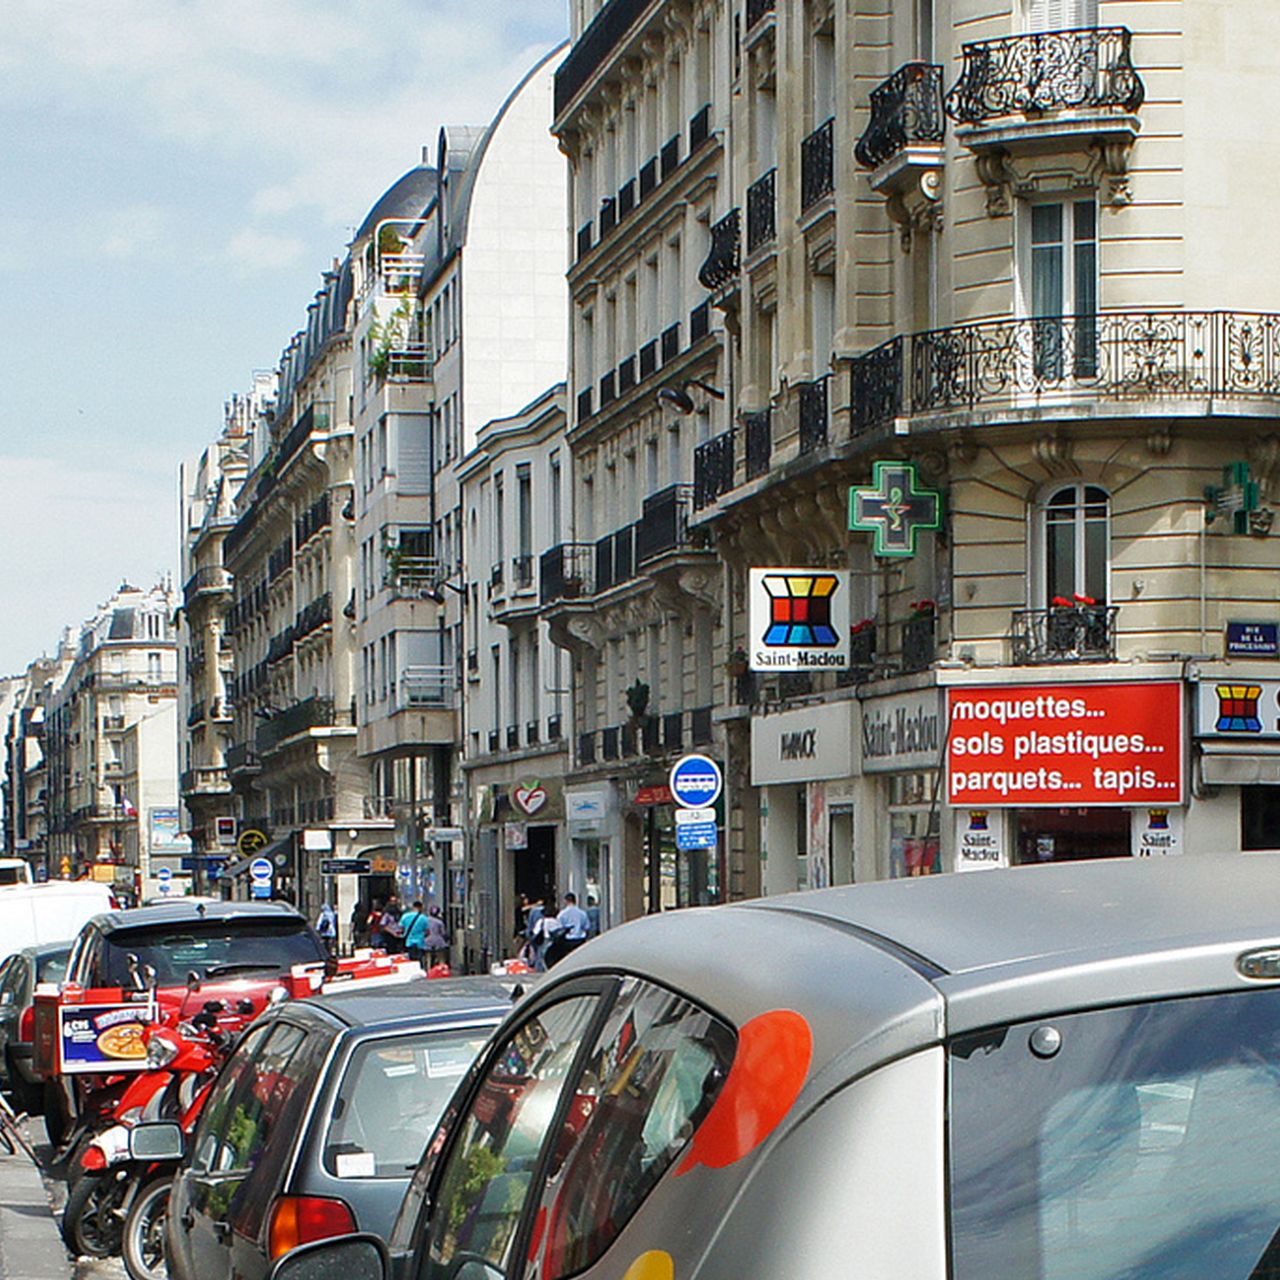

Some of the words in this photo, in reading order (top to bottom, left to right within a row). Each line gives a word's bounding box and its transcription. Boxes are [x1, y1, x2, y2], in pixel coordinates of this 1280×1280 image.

[755, 650, 846, 667] Saint-Maclou
[862, 705, 939, 759] Saint-Maclou
[951, 731, 1005, 756] sols
[1014, 730, 1166, 760] plastiques...
[951, 767, 1083, 796] parquets...
[1093, 766, 1177, 795] tapis...
